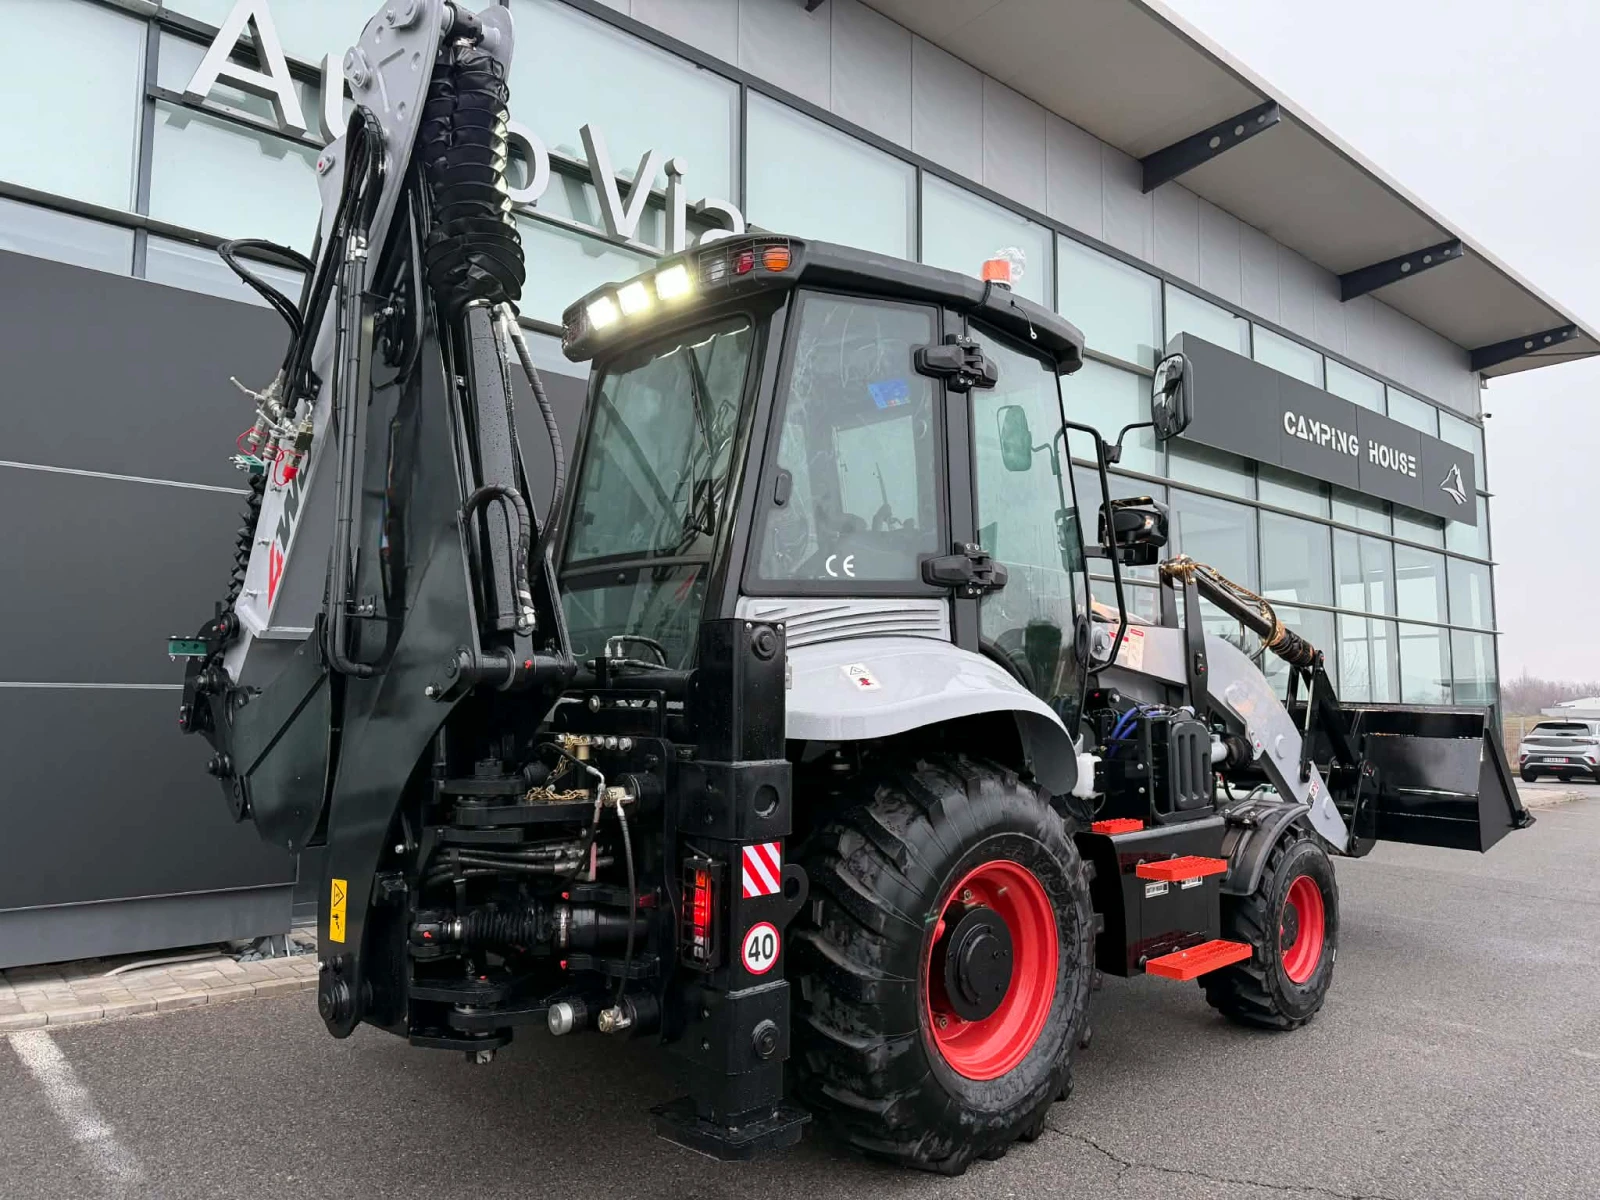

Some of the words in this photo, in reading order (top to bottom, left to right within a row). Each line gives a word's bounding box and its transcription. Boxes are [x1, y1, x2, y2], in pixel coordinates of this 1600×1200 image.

[181, 0, 550, 206] Ao
[1283, 411, 1359, 457] CAMPING
[1368, 440, 1417, 478] HOUSE
[825, 554, 856, 578] CE
[748, 932, 774, 962] 40
